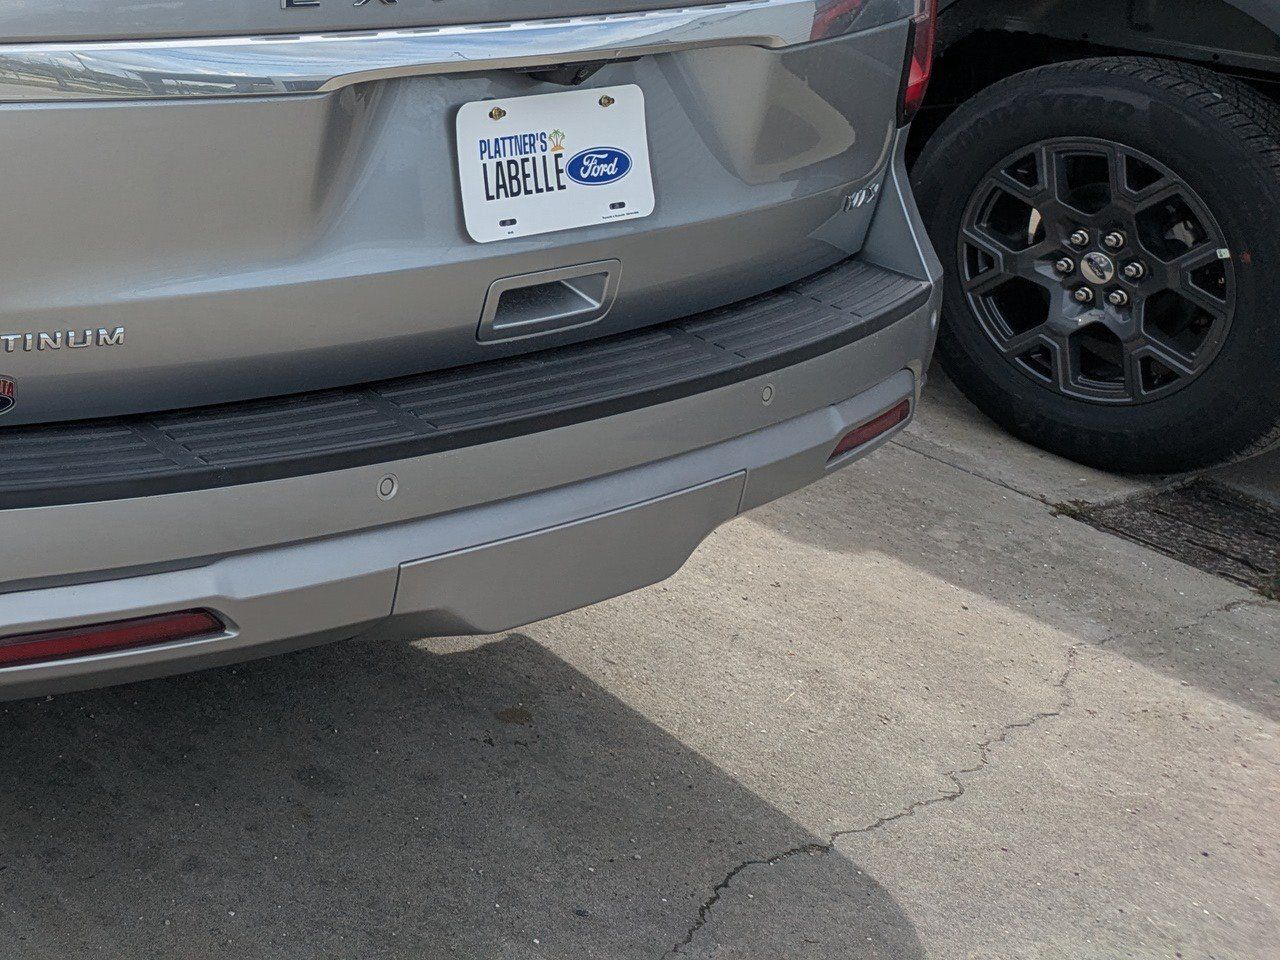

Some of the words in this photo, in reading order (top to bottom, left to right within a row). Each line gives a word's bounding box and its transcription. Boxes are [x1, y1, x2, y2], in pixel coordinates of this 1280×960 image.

[479, 131, 548, 161] PLATTNER'S
[482, 153, 567, 201] LABELLE
[579, 152, 619, 179] Ford
